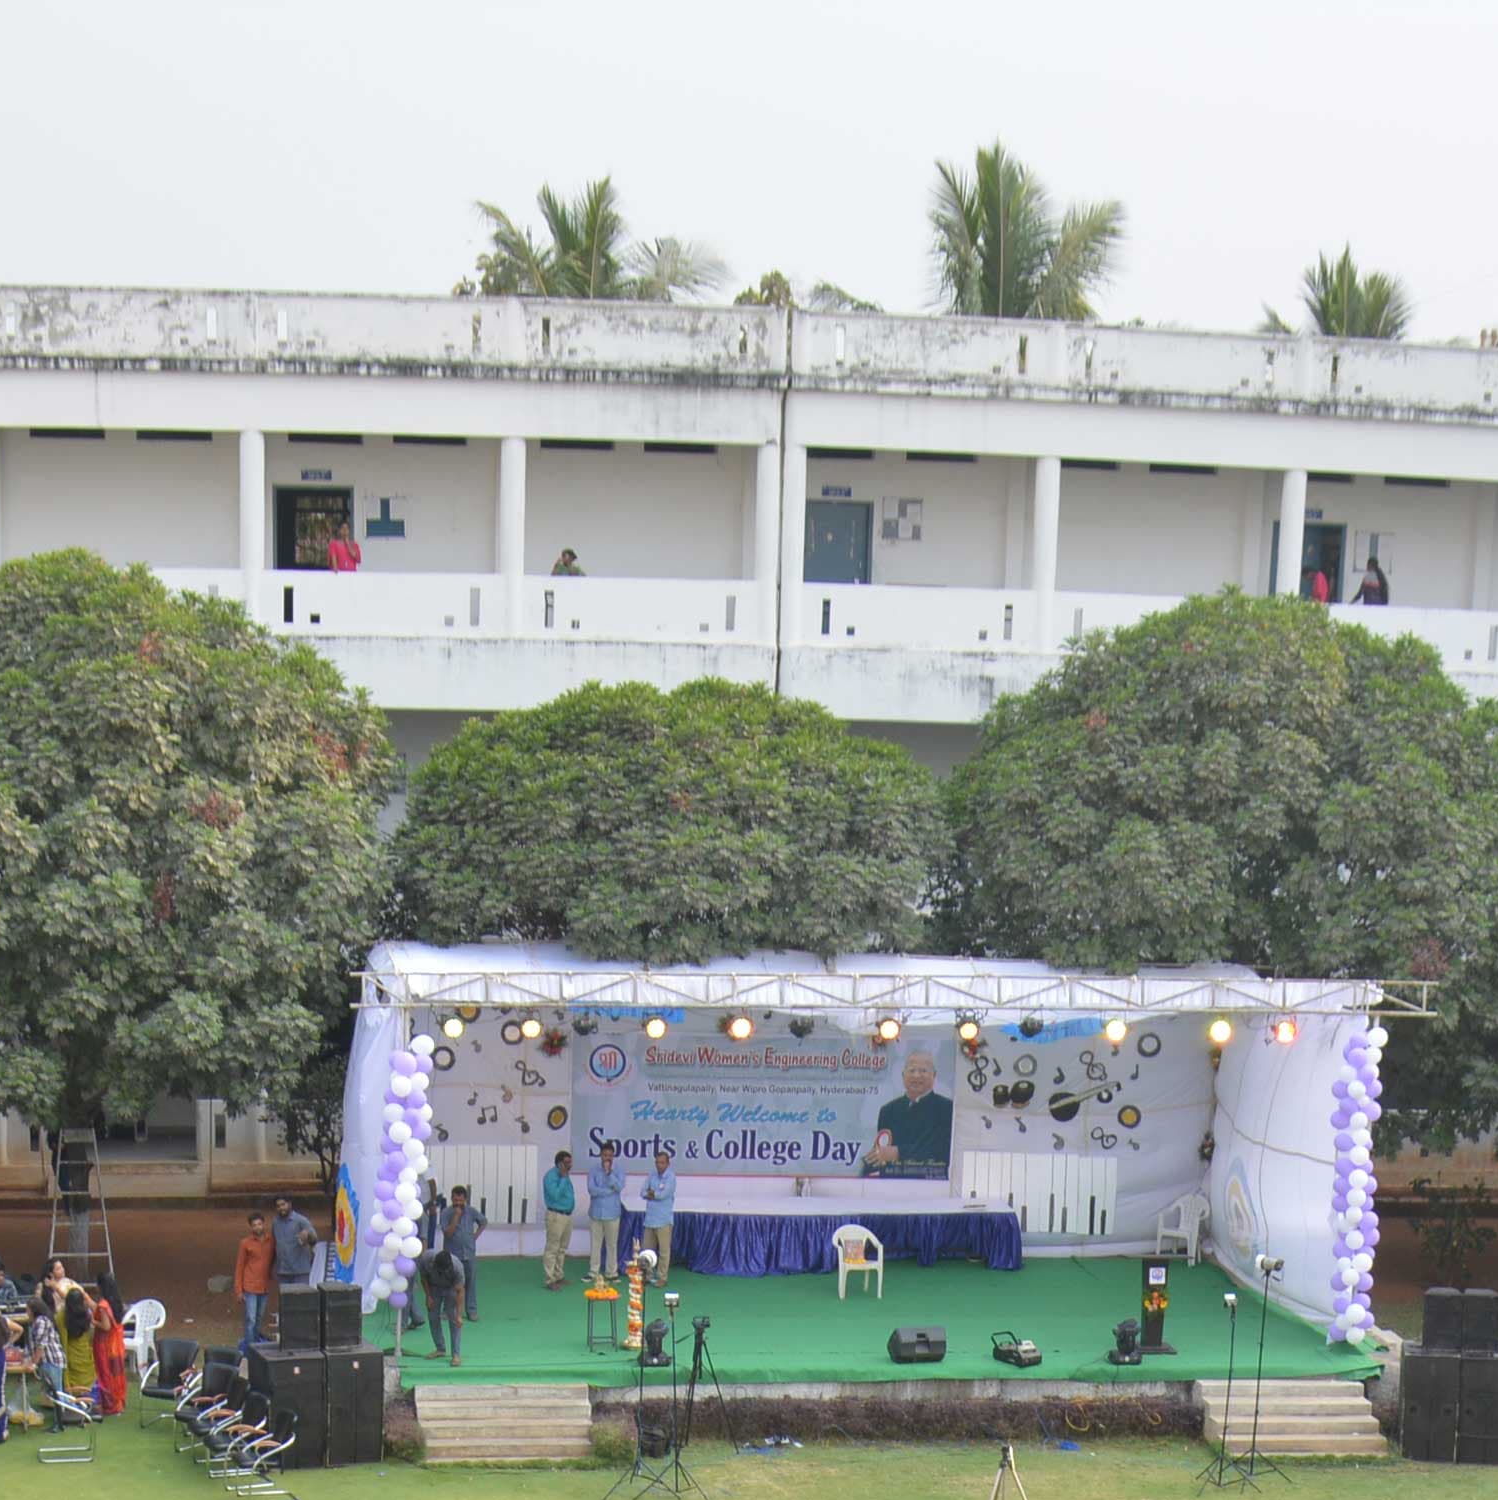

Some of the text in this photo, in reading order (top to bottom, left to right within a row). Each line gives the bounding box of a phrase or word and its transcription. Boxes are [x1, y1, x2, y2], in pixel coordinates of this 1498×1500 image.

[646, 1045, 886, 1070] Sridevi Women's Engineering College
[630, 1100, 837, 1127] Hearty Welcome to
[685, 1140, 699, 1159] &
[705, 1129, 801, 1166] College
[810, 1130, 861, 1166] Day
